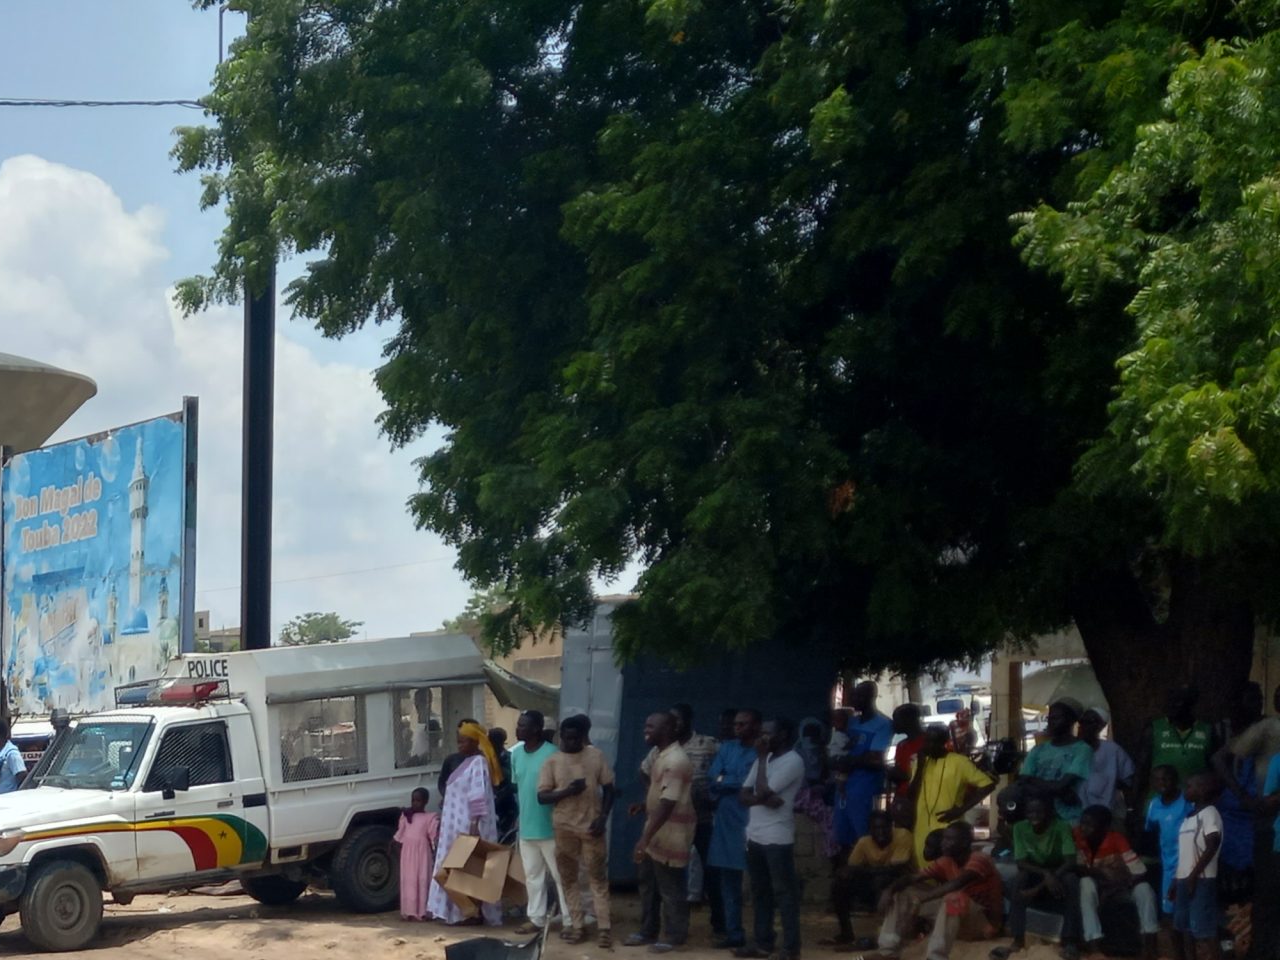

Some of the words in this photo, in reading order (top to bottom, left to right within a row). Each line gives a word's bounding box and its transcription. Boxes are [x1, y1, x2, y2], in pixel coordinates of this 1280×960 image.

[40, 474, 83, 517] Magal
[84, 471, 102, 504] de
[21, 519, 60, 553] Touba
[187, 659, 229, 678] POLICE
